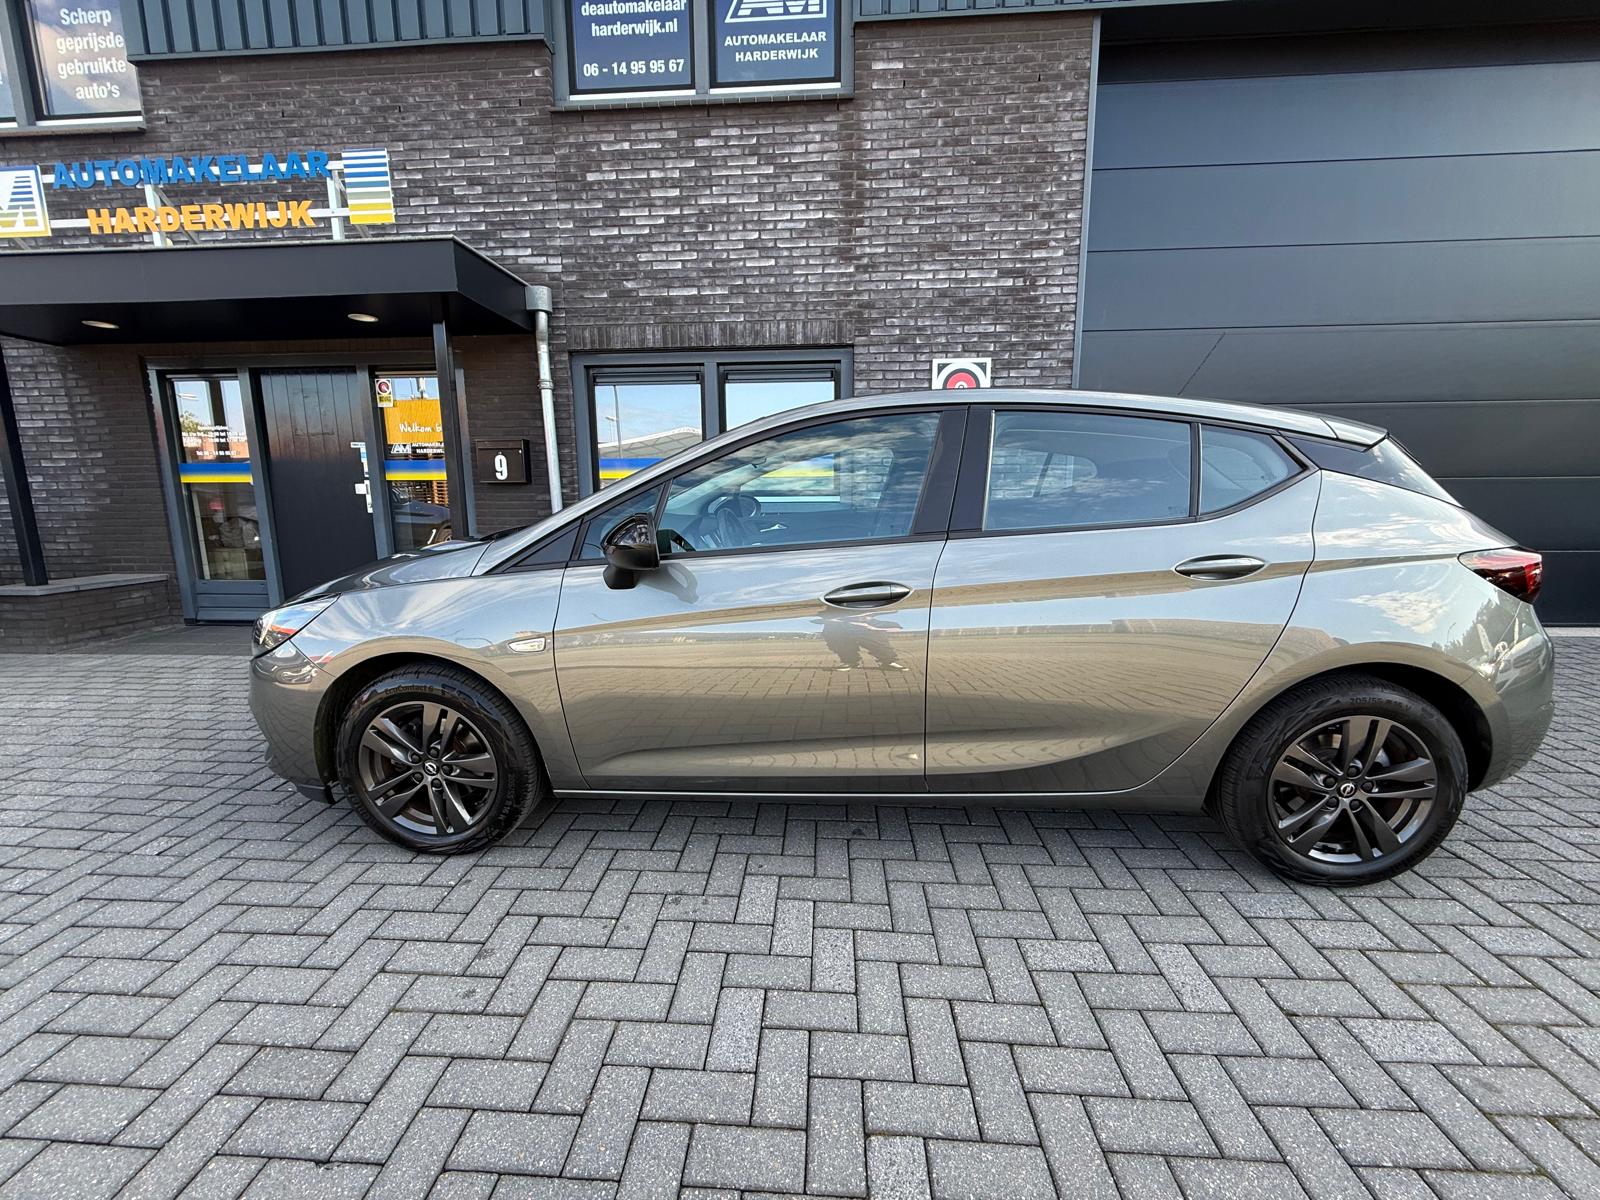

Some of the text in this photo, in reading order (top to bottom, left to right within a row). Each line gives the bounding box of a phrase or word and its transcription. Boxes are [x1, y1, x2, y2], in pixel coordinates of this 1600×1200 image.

[60, 7, 112, 26] Scherp
[581, 0, 686, 16] deautomakelaar
[591, 18, 678, 37] harderwijk.nl
[56, 31, 125, 54] geprijsde
[724, 31, 827, 47] AUTOMAKELAAR
[735, 48, 819, 62] HARDERWIJK
[57, 57, 127, 79] gebruikte
[583, 63, 599, 77] 06
[612, 62, 627, 75] 14
[630, 61, 646, 75] 95
[649, 60, 665, 73] 95
[668, 59, 685, 72] 67
[75, 82, 121, 99] auto's
[52, 150, 332, 190] AUTOMAKELAAR
[87, 200, 317, 235] HARDERWIJK
[399, 422, 432, 433] Welkom
[494, 454, 508, 481] 9
